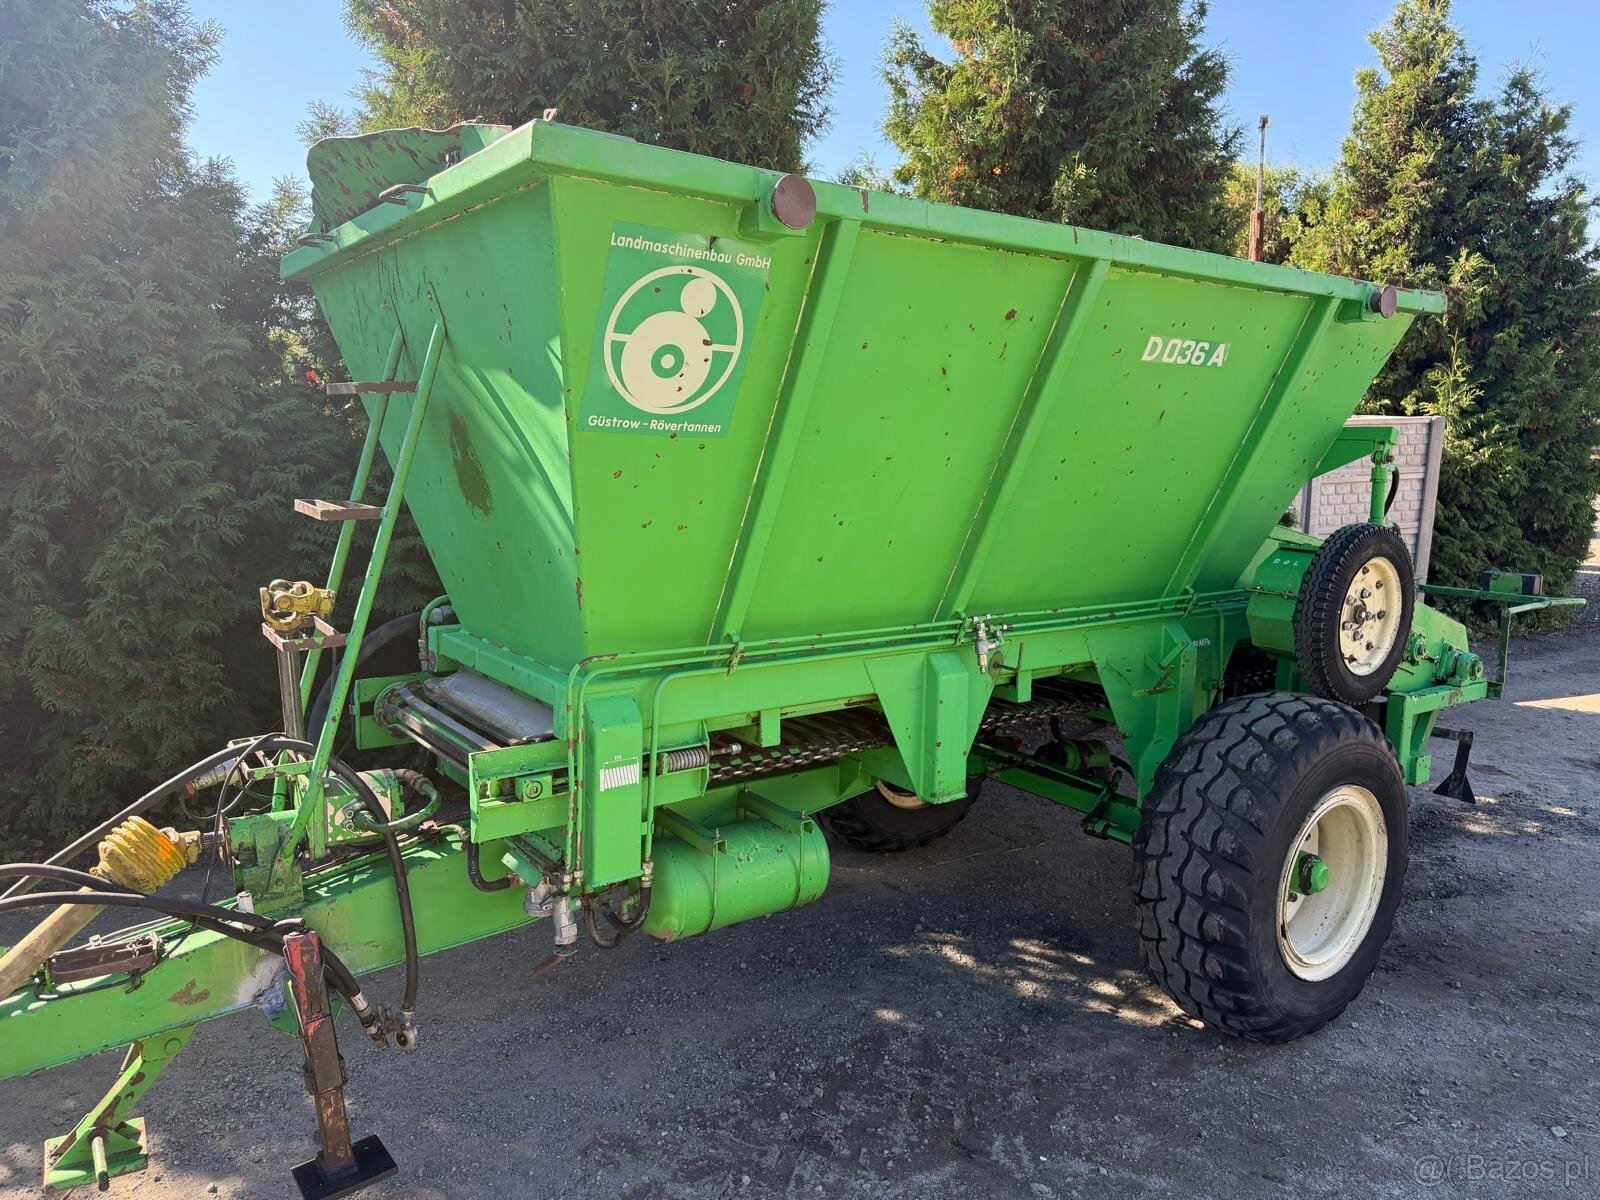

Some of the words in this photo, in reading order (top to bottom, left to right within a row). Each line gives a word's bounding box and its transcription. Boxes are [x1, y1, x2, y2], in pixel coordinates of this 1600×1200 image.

[610, 231, 732, 264] Landmaschinenbau
[736, 253, 772, 270] GmbH
[1141, 336, 1163, 361] D
[1206, 343, 1226, 368] A
[587, 415, 640, 430] Güstrow
[650, 419, 722, 434] Rövertannen
